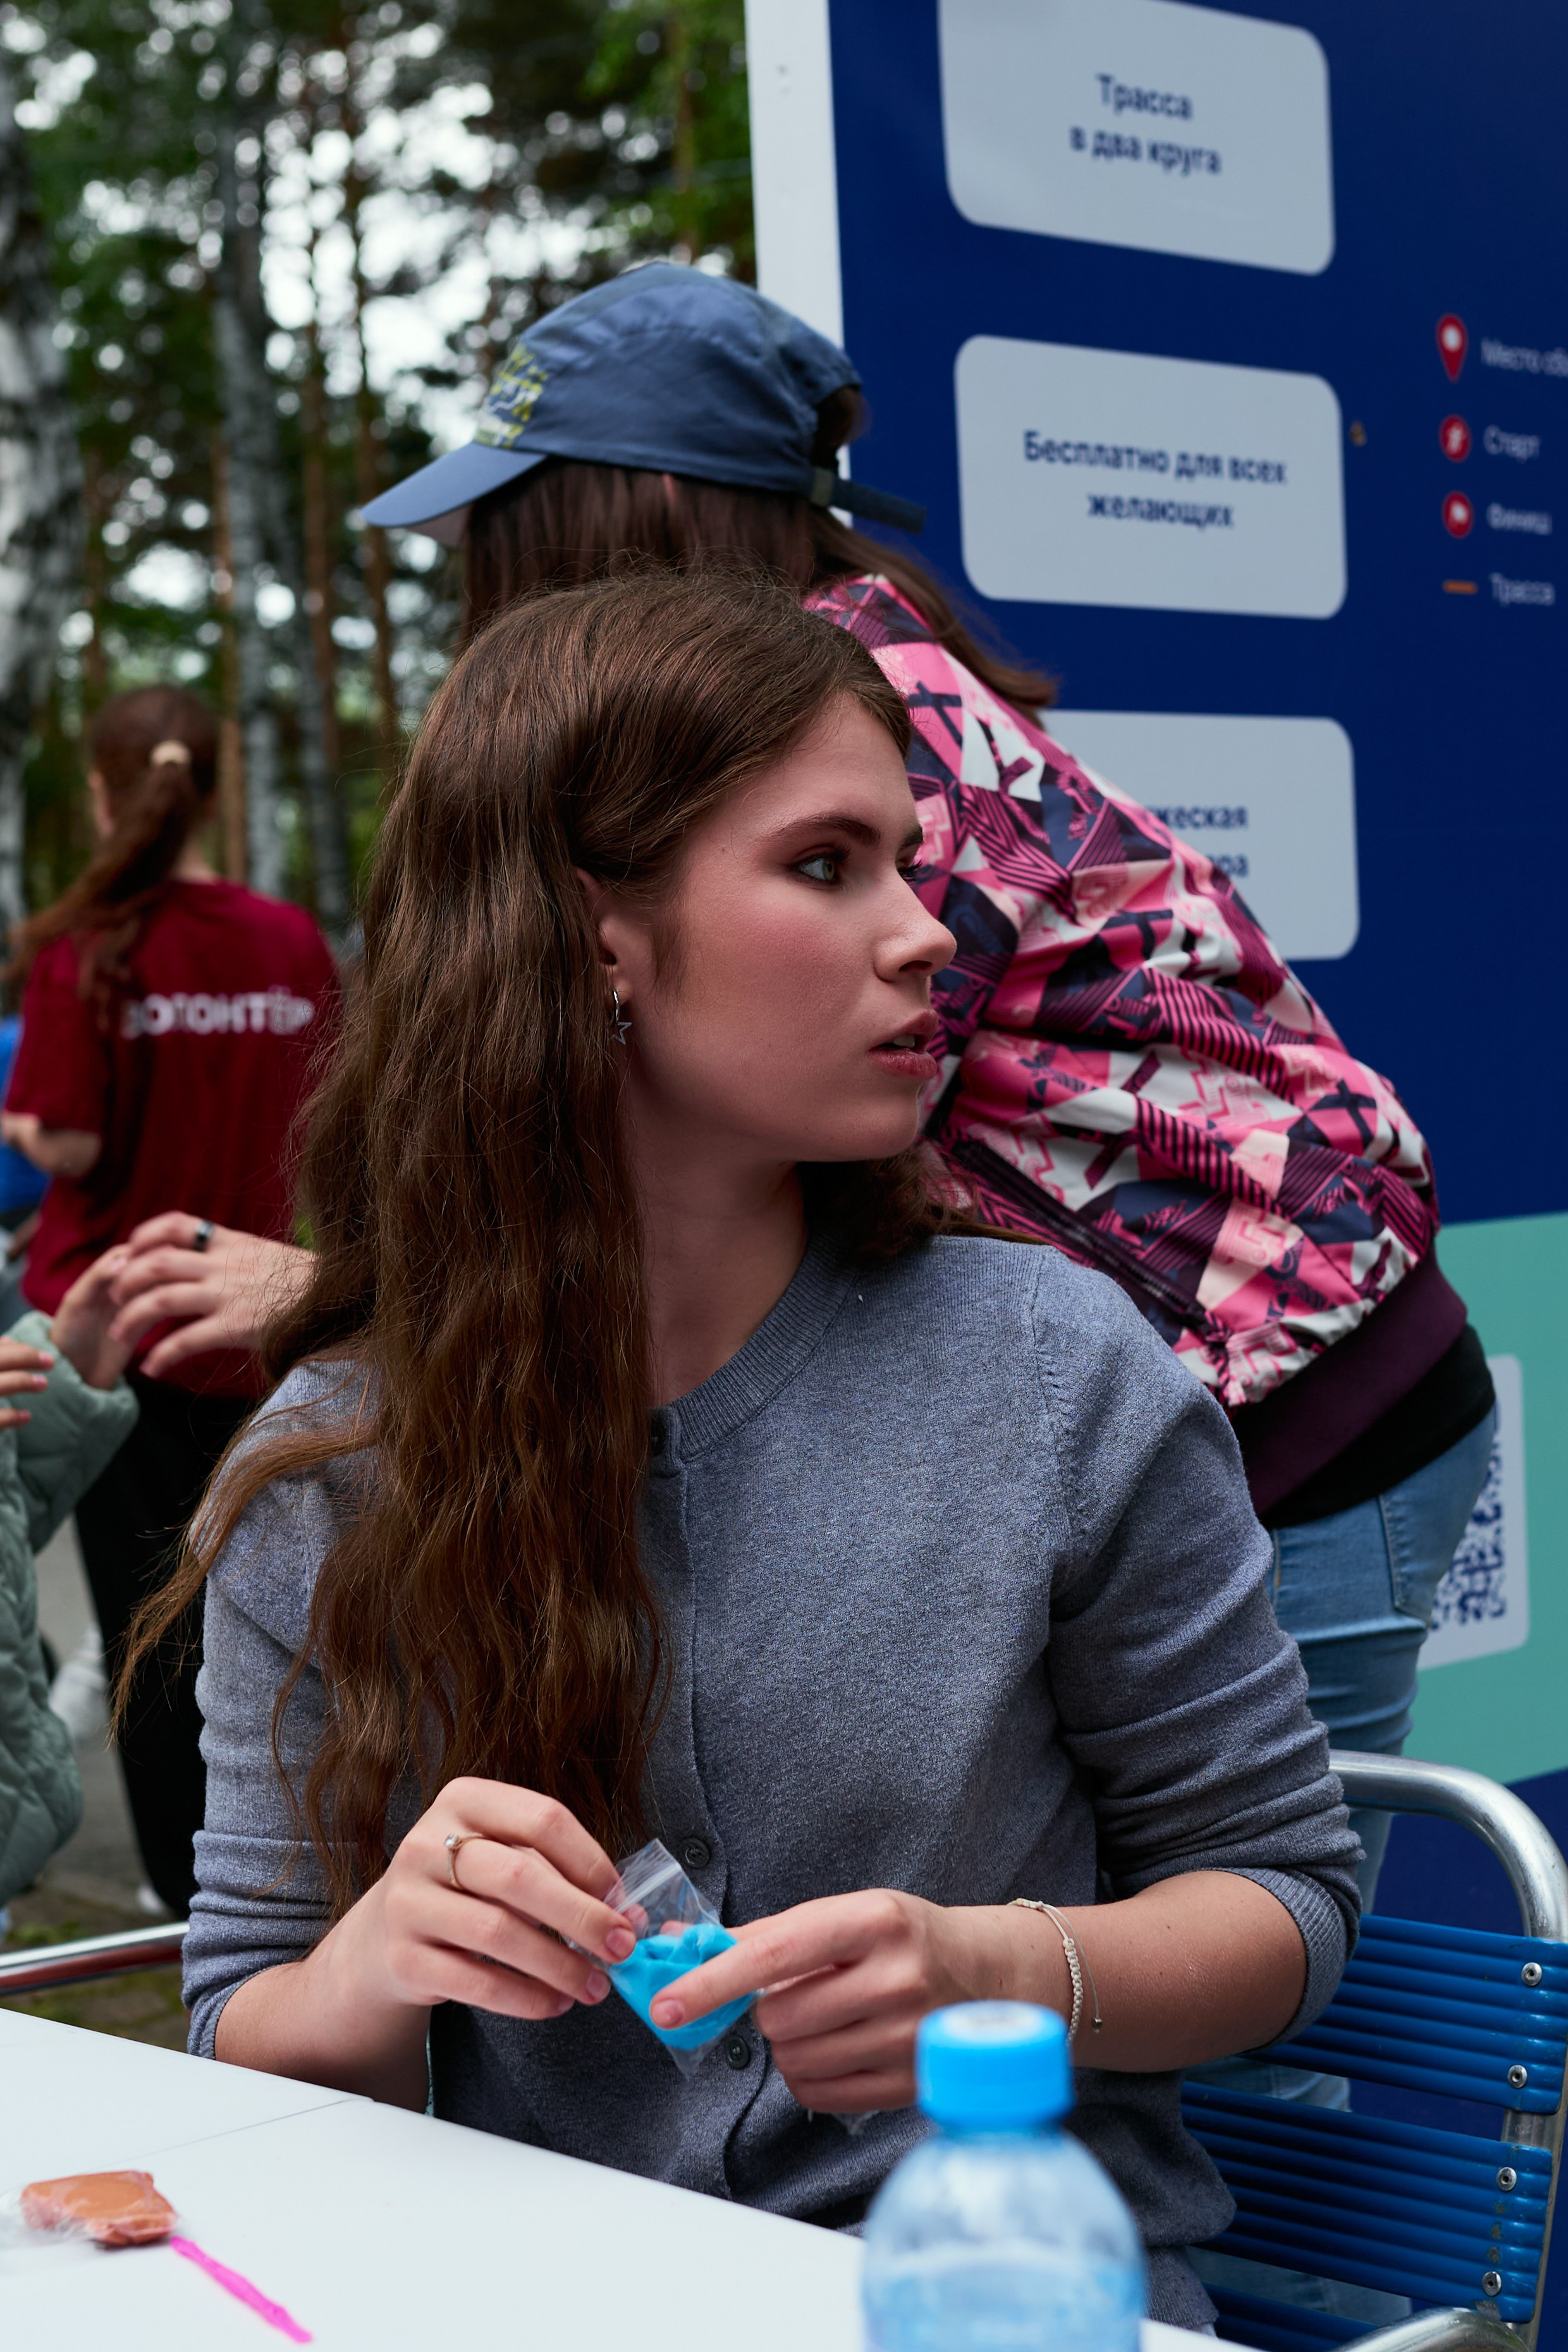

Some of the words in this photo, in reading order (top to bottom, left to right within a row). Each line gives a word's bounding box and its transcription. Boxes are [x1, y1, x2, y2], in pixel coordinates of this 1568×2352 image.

[1096, 73, 1193, 120] Трасса
[1070, 126, 1087, 152] в
[1091, 130, 1142, 162] два
[1148, 139, 1222, 176] круга
[1023, 429, 1170, 474] Бесплатно
[1174, 451, 1223, 481] для
[1228, 456, 1287, 484] всех
[1087, 494, 1233, 530] желающих
